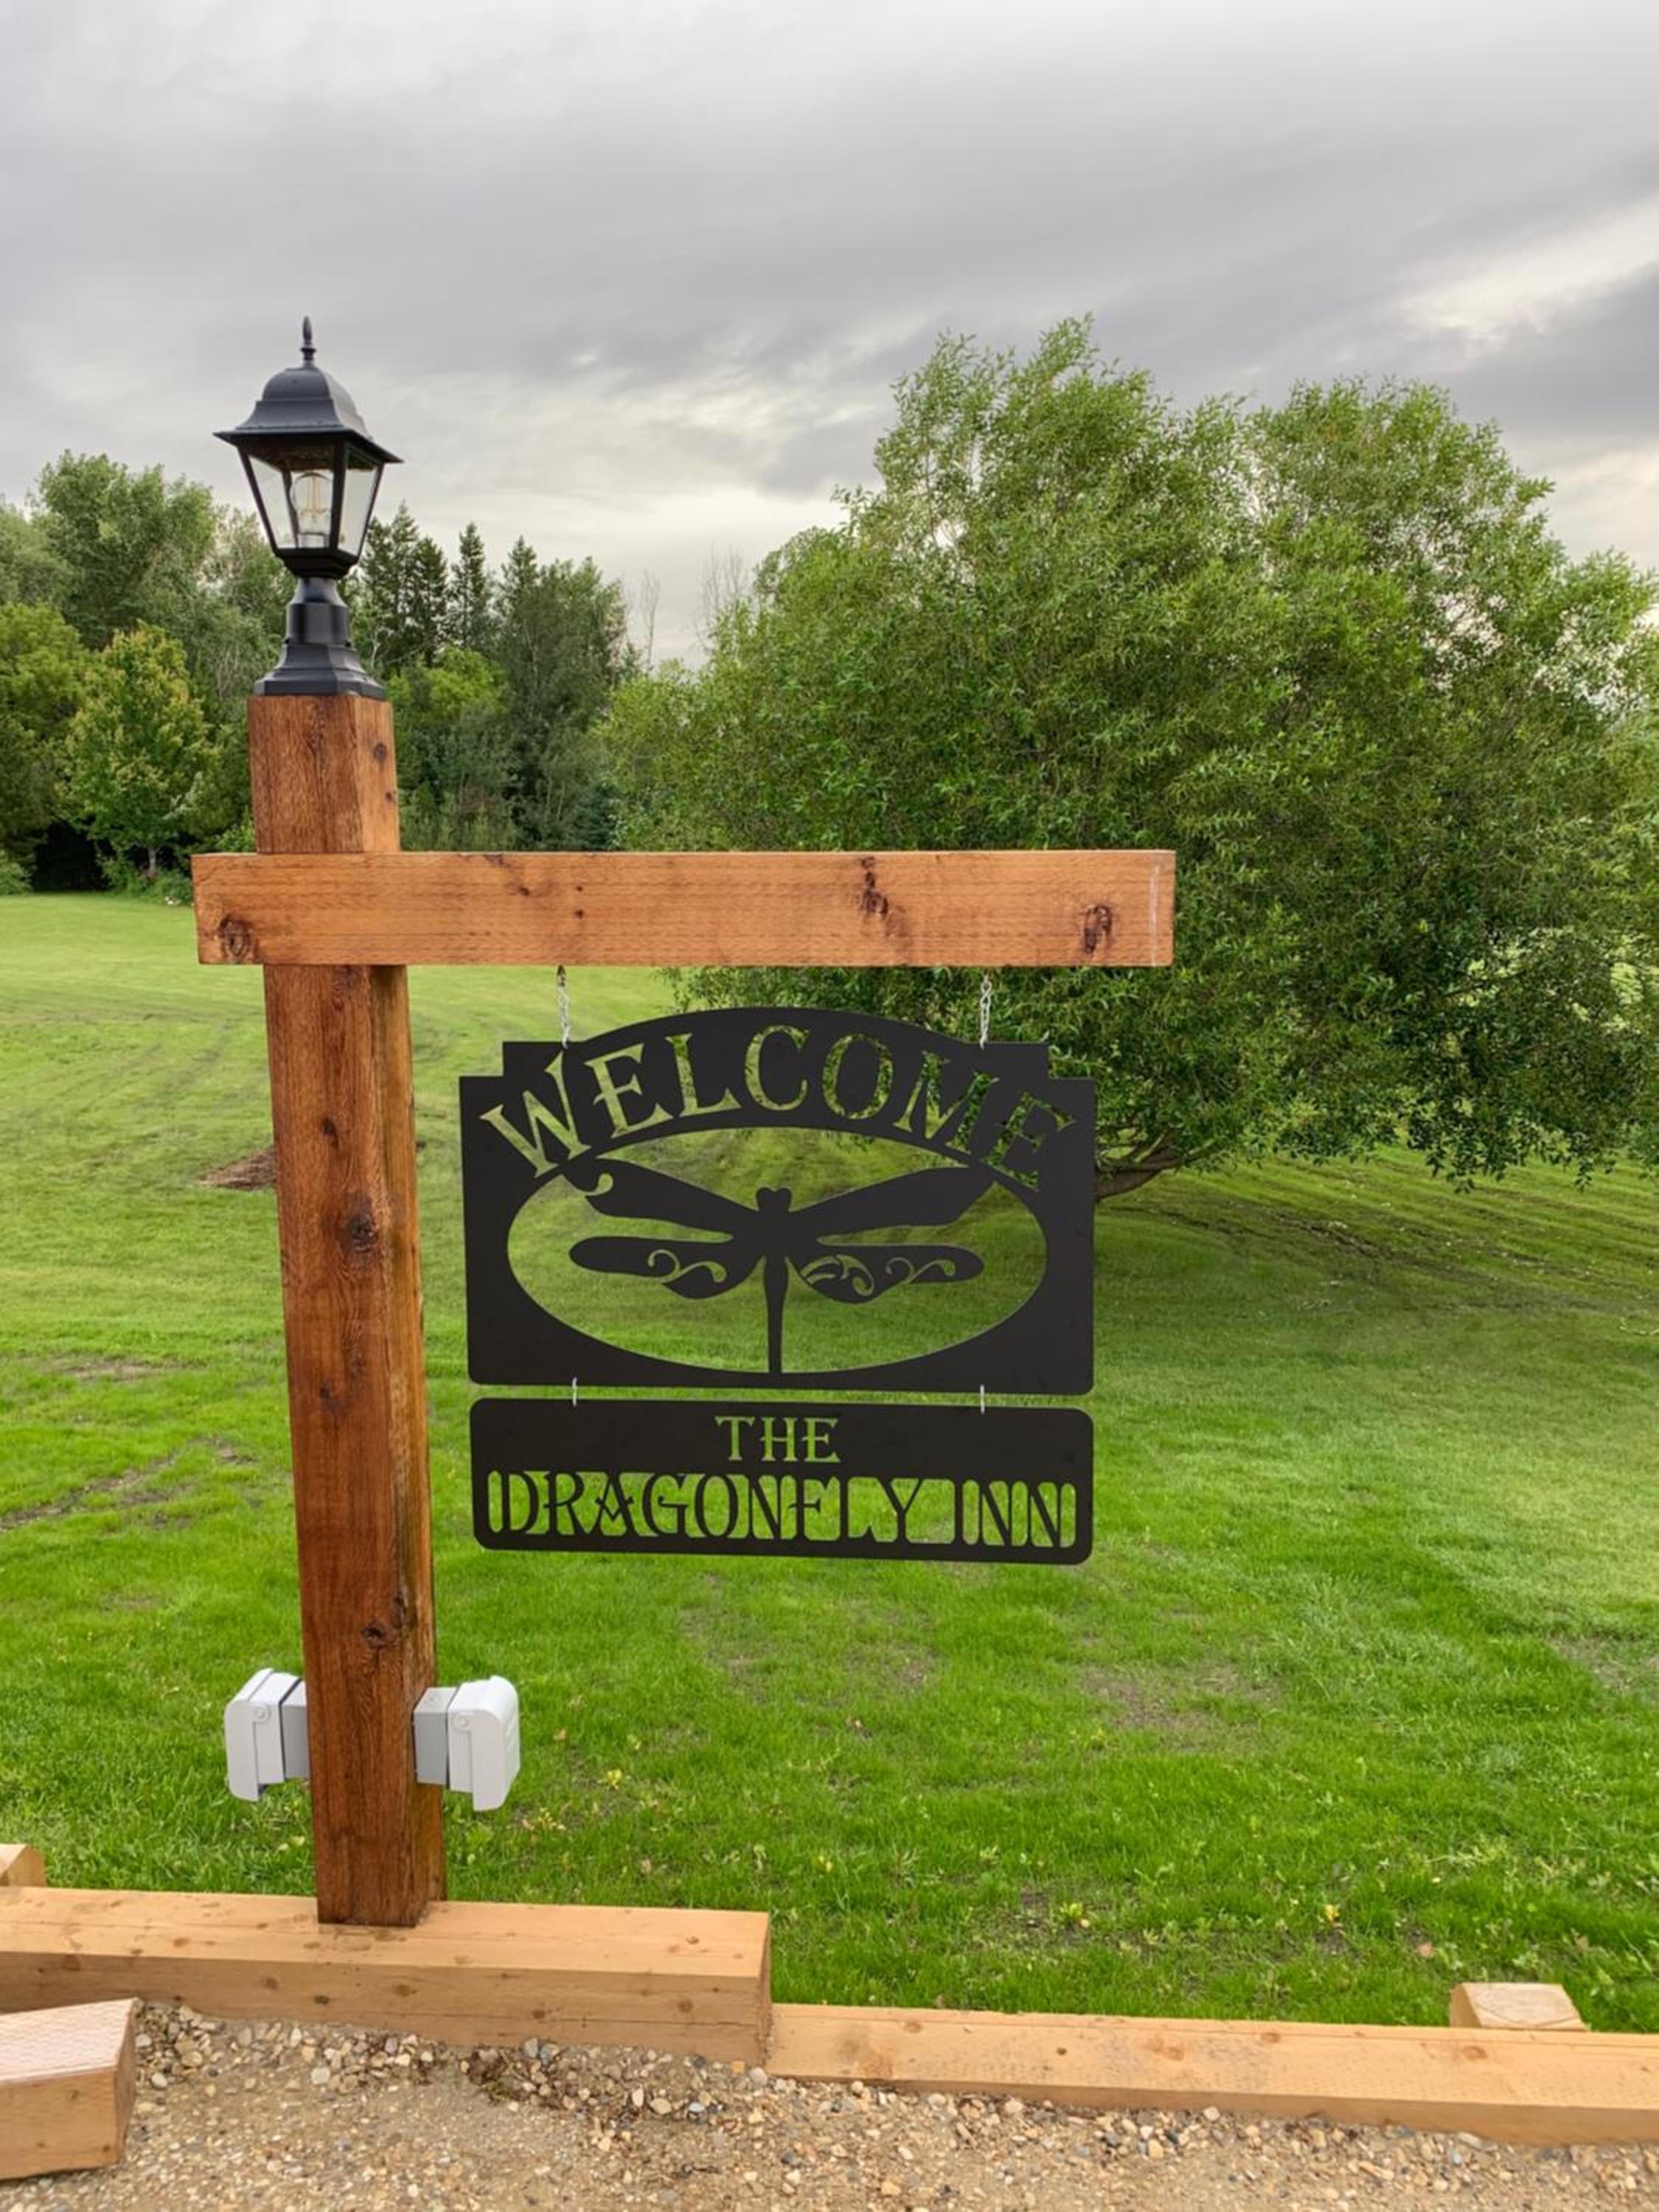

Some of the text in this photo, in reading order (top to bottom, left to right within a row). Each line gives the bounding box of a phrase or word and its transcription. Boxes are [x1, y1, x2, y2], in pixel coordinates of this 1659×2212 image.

[479, 1024, 1077, 1192] WELCOME
[713, 1415, 841, 1463] THE
[498, 1470, 1065, 1548] DRAGONFLY INN
